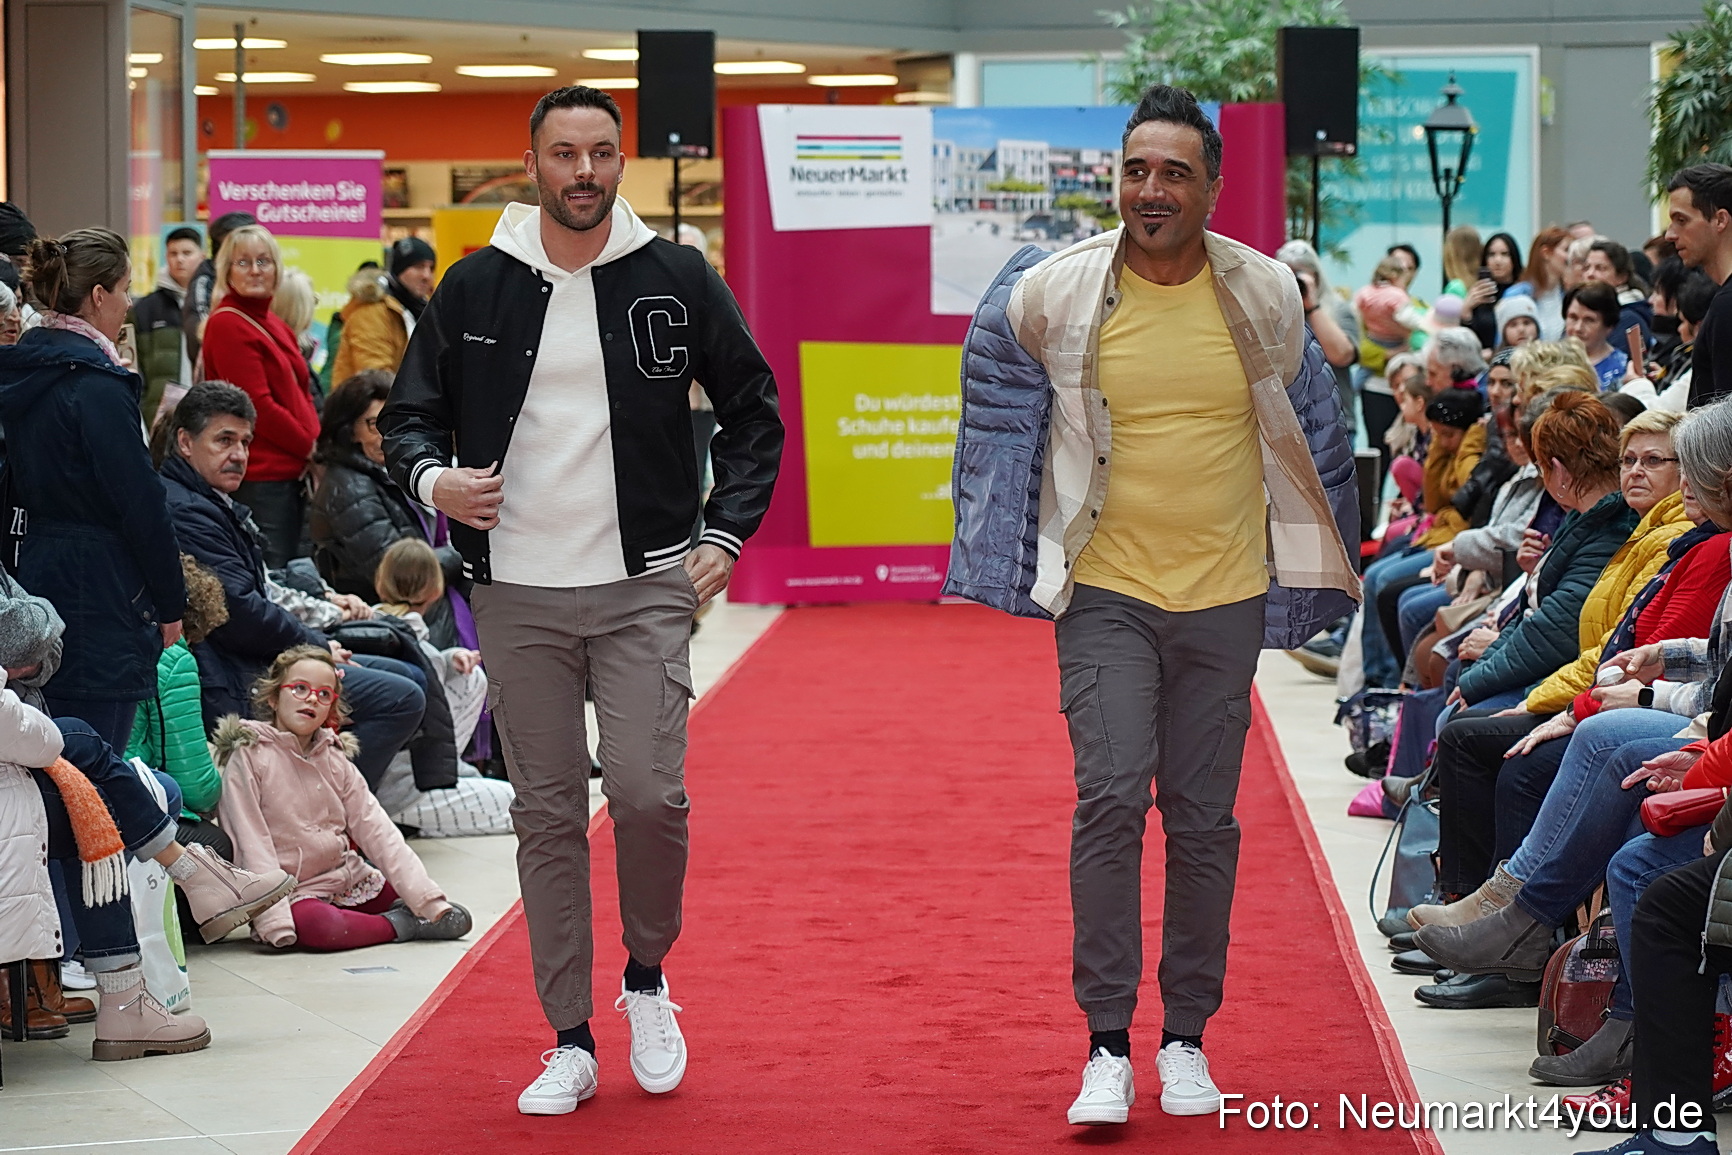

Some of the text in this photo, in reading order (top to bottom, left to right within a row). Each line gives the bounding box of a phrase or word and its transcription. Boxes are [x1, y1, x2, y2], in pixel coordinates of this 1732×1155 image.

[791, 166, 908, 182] NeuerMarkt
[218, 180, 367, 201] Verschenken Sie
[256, 202, 367, 223] Gutscheine!
[628, 296, 688, 378] C
[855, 393, 959, 412] Du würdest
[837, 416, 905, 436] Schuhe
[852, 440, 889, 459] und
[146, 873, 158, 890] 5
